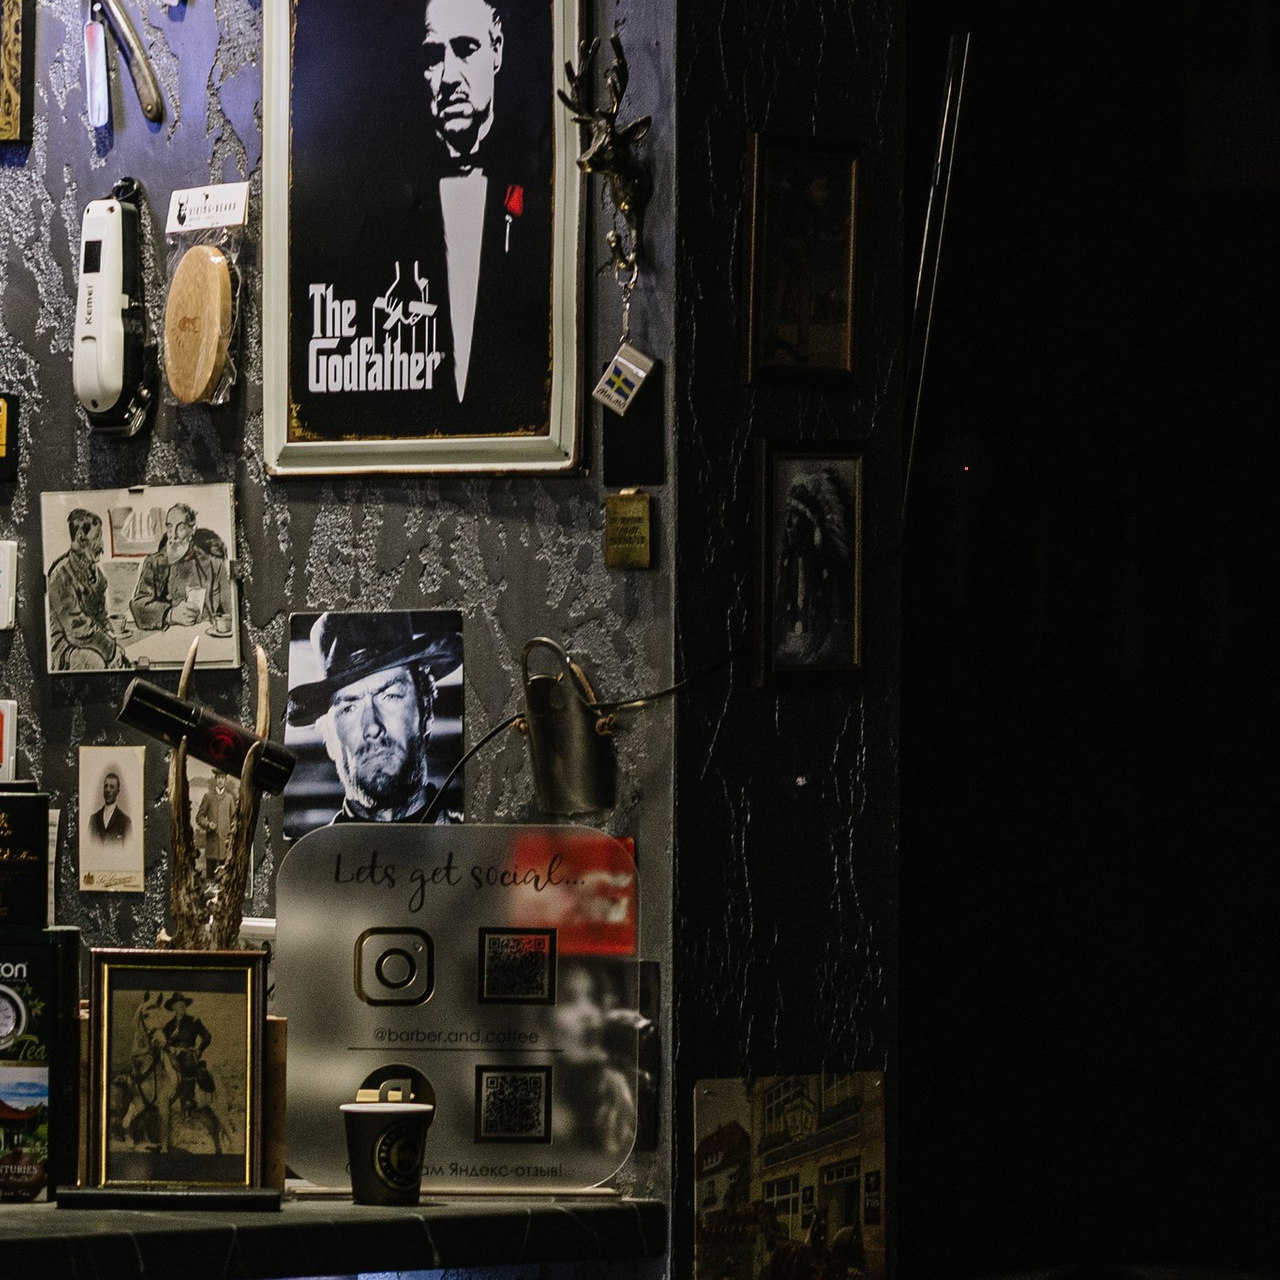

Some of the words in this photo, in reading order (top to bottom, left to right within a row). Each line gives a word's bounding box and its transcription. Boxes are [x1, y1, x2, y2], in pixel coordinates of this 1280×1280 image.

[309, 283, 357, 338] The
[308, 336, 441, 393] Godfather
[334, 850, 395, 888] Lets
[409, 851, 463, 913] get
[421, 1165, 445, 1177] ам
[449, 1163, 563, 1178] Яндекс-отзыв!
